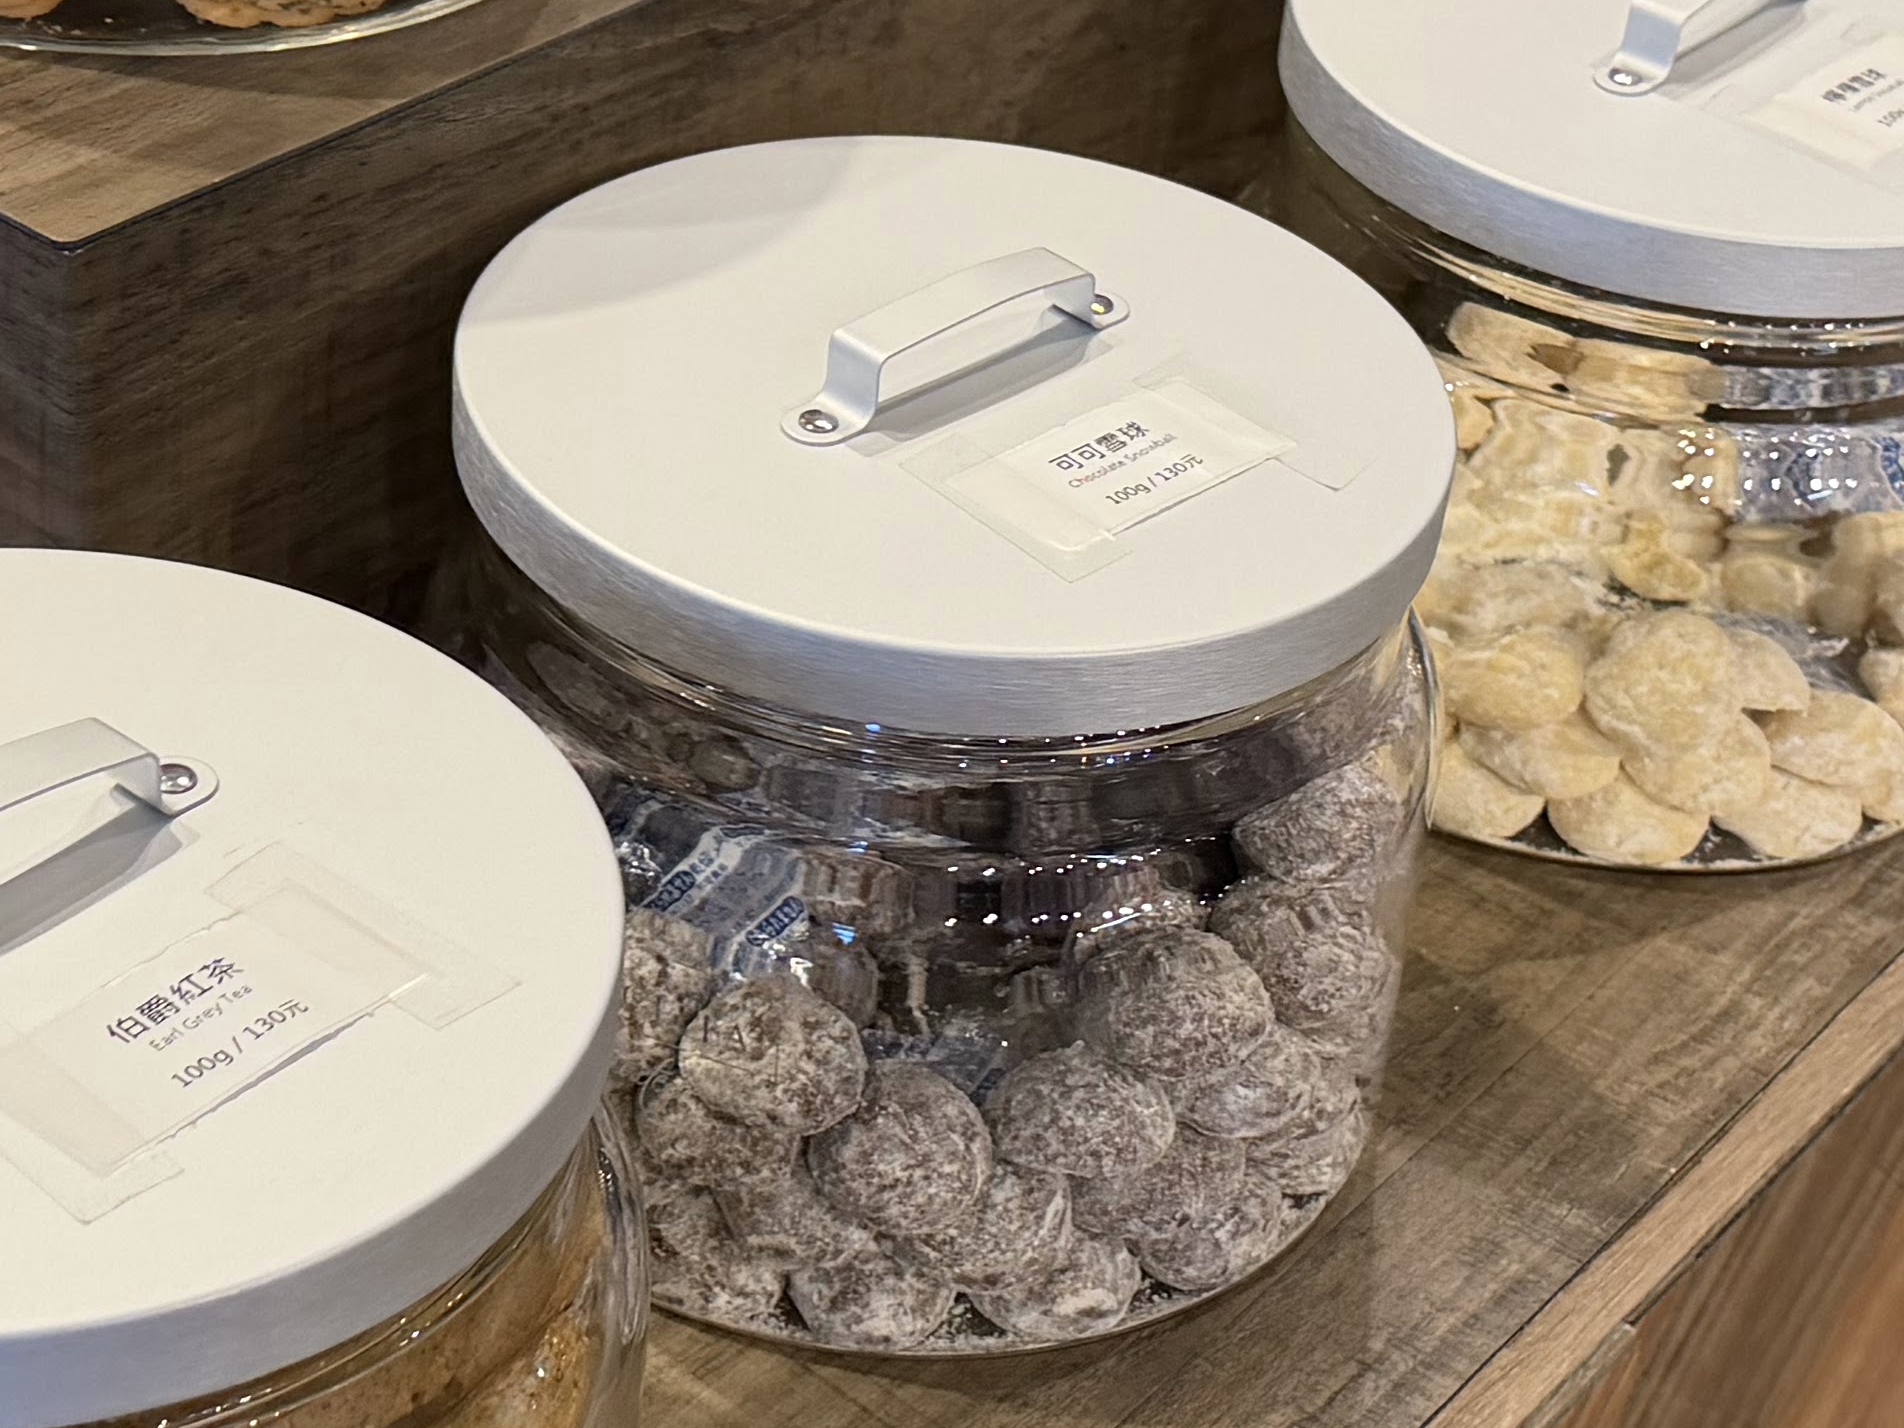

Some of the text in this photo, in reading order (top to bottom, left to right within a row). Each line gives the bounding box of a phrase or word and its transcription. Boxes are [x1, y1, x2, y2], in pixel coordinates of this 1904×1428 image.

[1048, 420, 1150, 473] 可可雪球
[1105, 480, 1151, 506] 100g
[1155, 454, 1204, 482] 130元
[106, 956, 245, 1045] 伯爵紅茶
[150, 983, 252, 1052] Earl Grey Tea
[171, 1049, 234, 1088] 100g
[244, 998, 310, 1041] 130元
